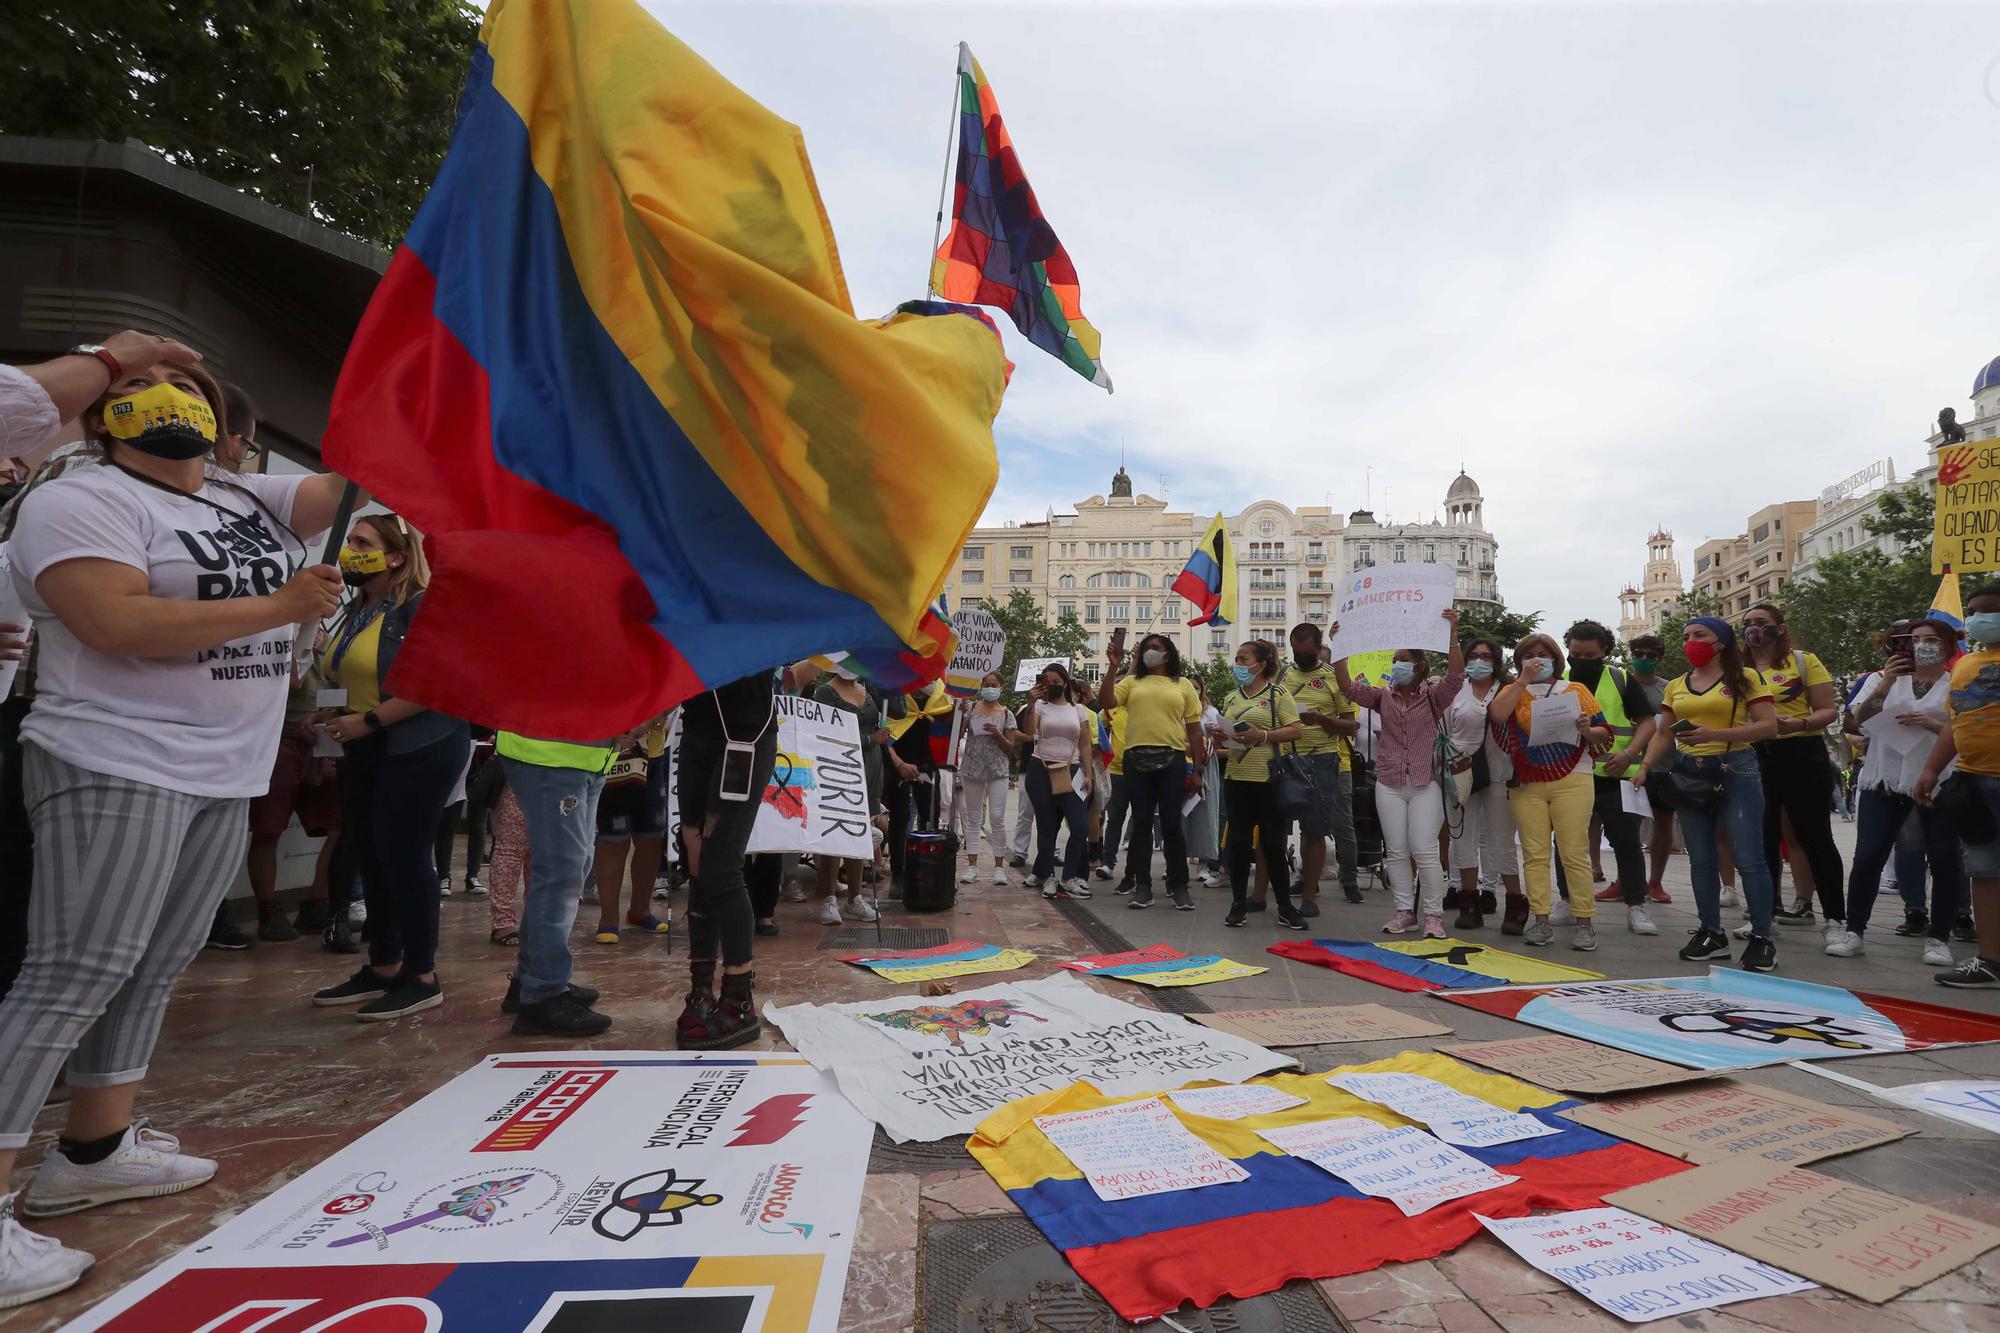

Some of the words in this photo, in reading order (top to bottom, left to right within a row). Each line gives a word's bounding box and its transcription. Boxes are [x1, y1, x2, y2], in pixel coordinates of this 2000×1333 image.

[112, 402, 132, 415] 5763
[1961, 538, 1986, 565] ES
[1356, 589, 1424, 608] MUERTES
[972, 614, 996, 628] VIVA
[223, 645, 253, 660] PAZ
[965, 643, 993, 655] ESTAN
[210, 663, 270, 680] NUESTRA
[831, 706, 844, 727] A
[815, 734, 867, 838] MORIR
[532, 1070, 562, 1087] país
[902, 1060, 969, 1087] UNA
[484, 1086, 534, 1123] valencià
[676, 1069, 750, 1149] INTERSINDICAL
[642, 1080, 707, 1149] VALENCIANA
[1809, 1116, 1848, 1129] NO
[1457, 1125, 1543, 1143] COLOMBIA
[1182, 1160, 1229, 1174] VIOLA
[1323, 1148, 1398, 1173] HABLAMOS
[1415, 1150, 1460, 1169] NOS
[1093, 1170, 1163, 1187] TORTURA
[1162, 1176, 1218, 1188] POLICIA
[1164, 1167, 1178, 1178] Y
[1221, 1168, 1243, 1181] LA
[1355, 1166, 1416, 1186] MATAN
[402, 1183, 447, 1219] Mujeres
[552, 1191, 580, 1215] ESPAÑA
[760, 1163, 804, 1224] Movice
[562, 1180, 615, 1227] REVIVIR
[421, 1217, 514, 1233] Migradas
[1570, 1225, 1590, 1235] DE
[1614, 1217, 1640, 1227] EL
[282, 1216, 342, 1250] AESCO
[362, 1224, 390, 1252] COLECTIVA
[1531, 1230, 1570, 1241] ABRIL
[1617, 1231, 1640, 1241] DE
[1752, 1226, 1823, 1256] EN
[1541, 1244, 1580, 1258] DESDE
[1687, 1238, 1732, 1258] OS
[1665, 1274, 1759, 1301] DONDE
